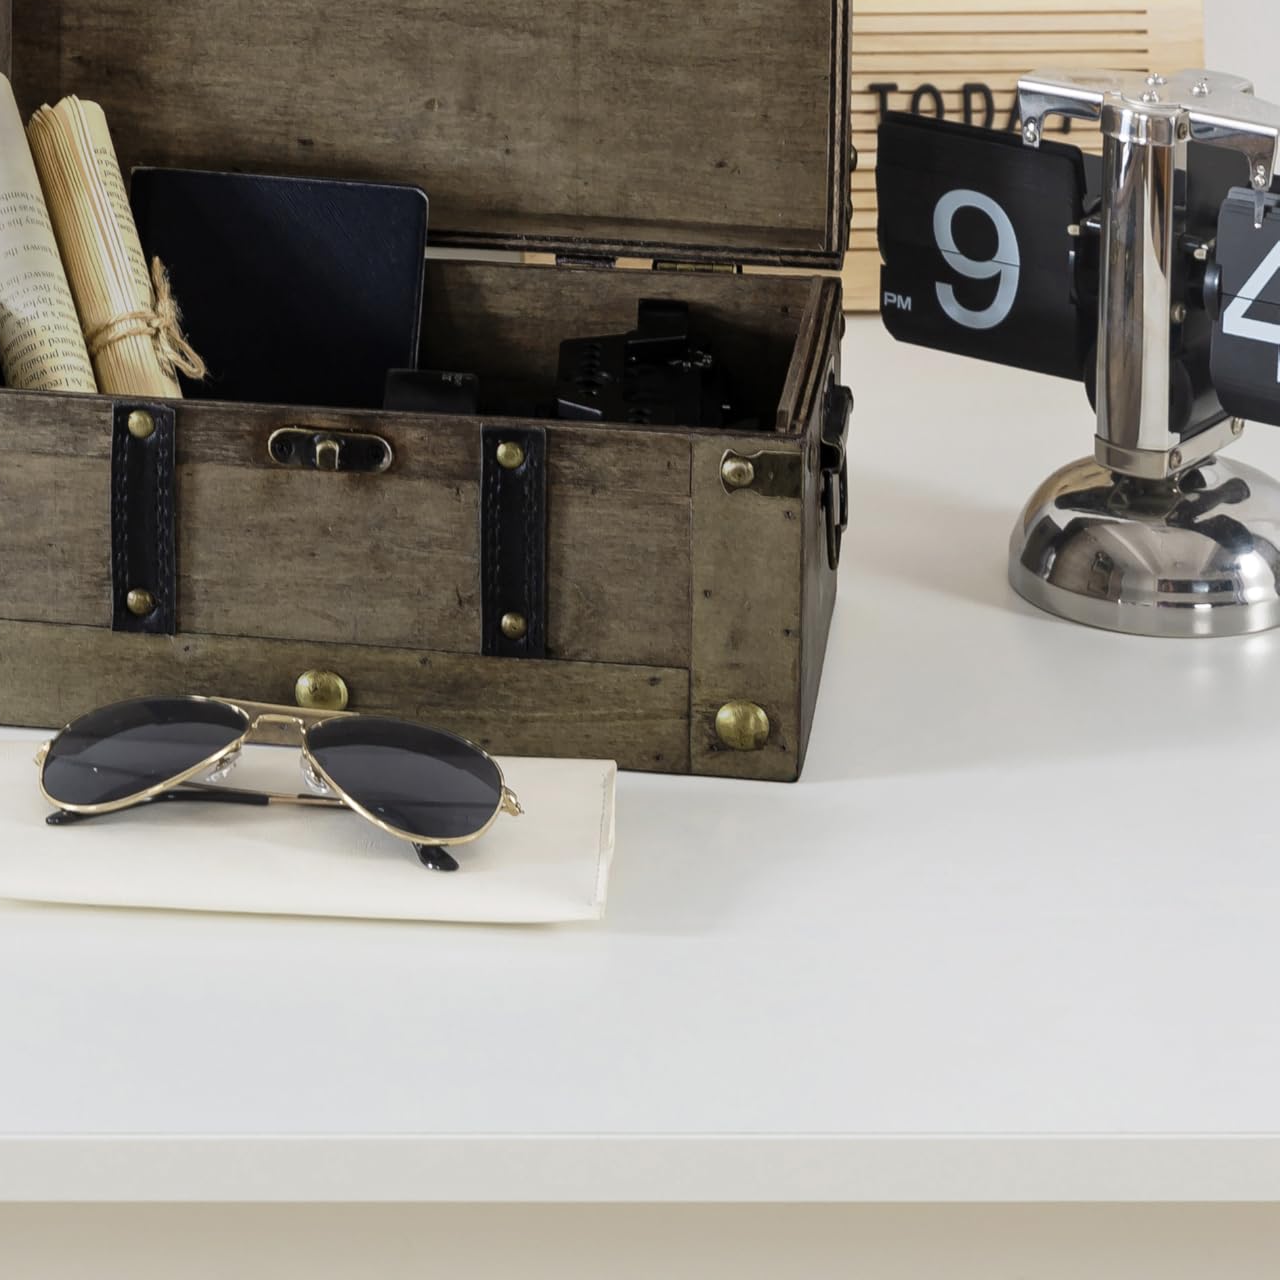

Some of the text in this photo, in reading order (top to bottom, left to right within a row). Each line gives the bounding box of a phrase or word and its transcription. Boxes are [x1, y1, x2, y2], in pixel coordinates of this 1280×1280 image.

[868, 83, 1072, 136] TOD
[933, 189, 1020, 329] 9
[884, 291, 912, 312] PM
